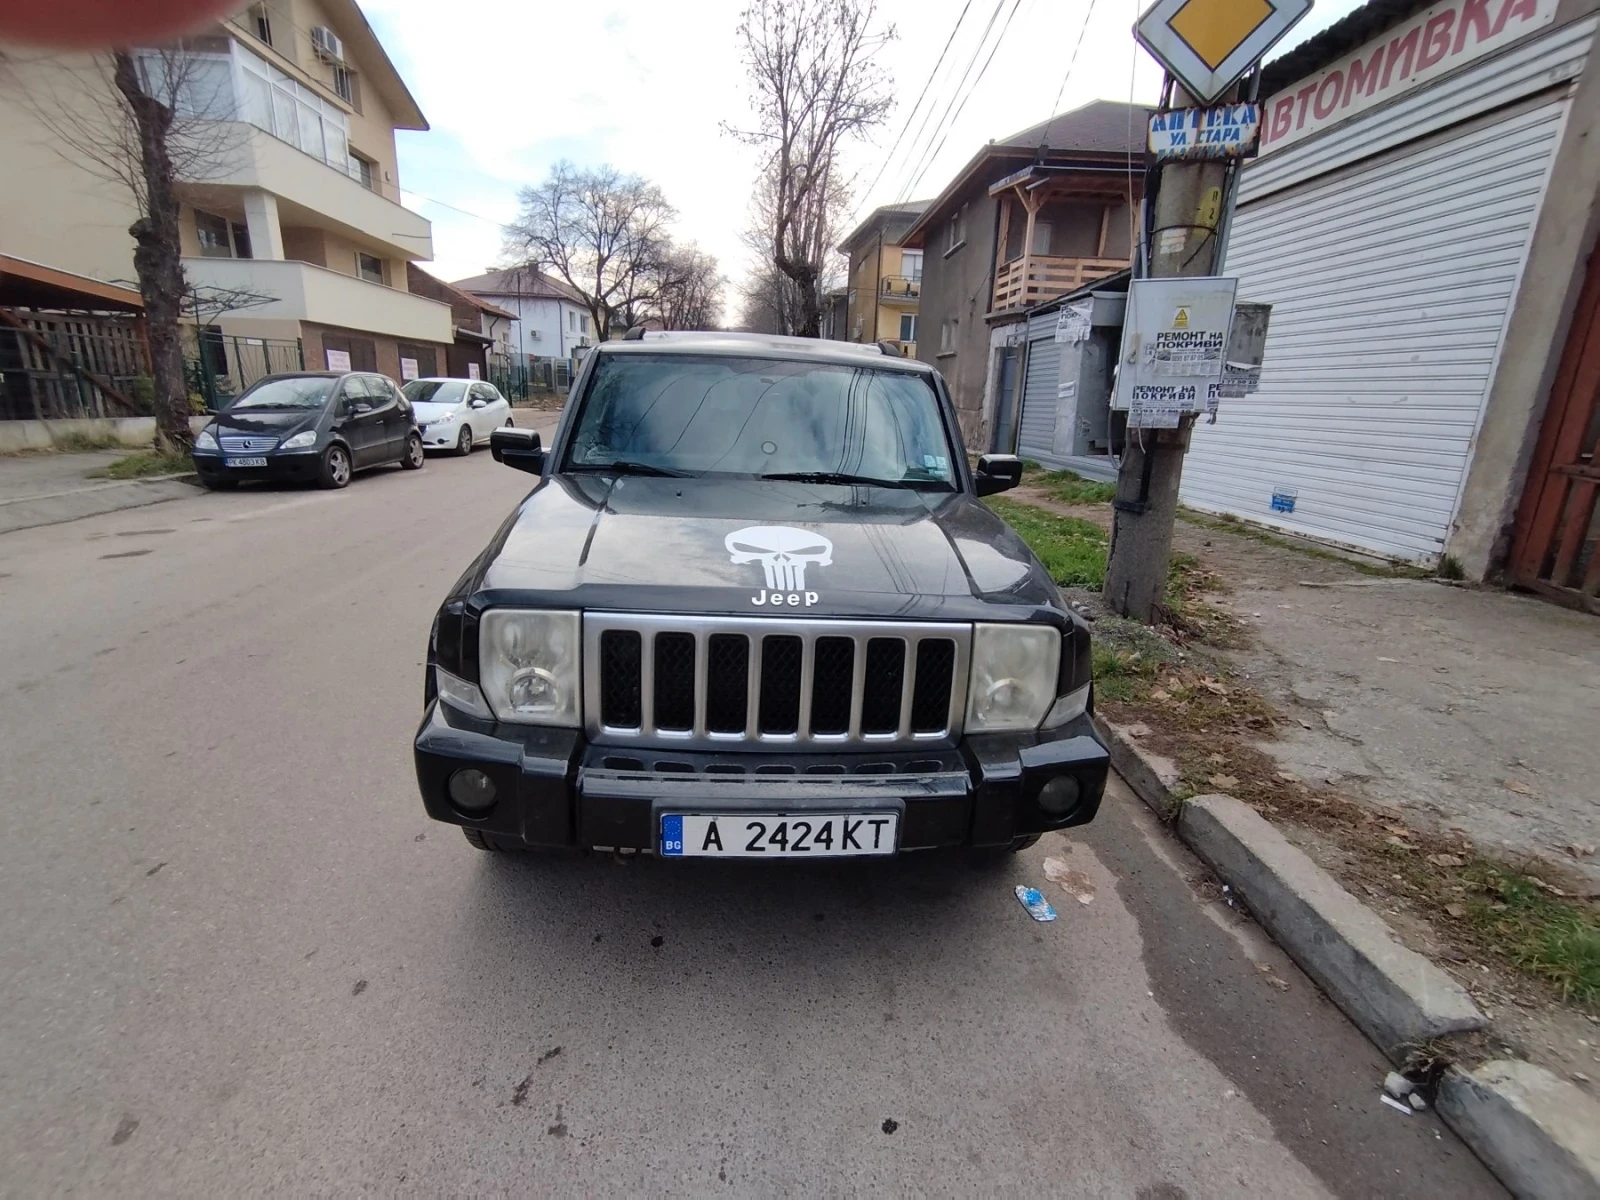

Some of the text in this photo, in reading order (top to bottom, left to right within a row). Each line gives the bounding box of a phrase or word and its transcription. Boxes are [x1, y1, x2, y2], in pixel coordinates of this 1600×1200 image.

[1196, 127, 1240, 144] СТАРА
[1157, 331, 1223, 341] РЕМОНТ НА
[1156, 340, 1222, 348] ПОКРИВИ
[1133, 385, 1176, 393] РЕМОНТ
[1132, 392, 1196, 400] ПОКРИВИ
[751, 589, 819, 607] Jeep
[665, 840, 682, 850] BG
[702, 820, 724, 851] A
